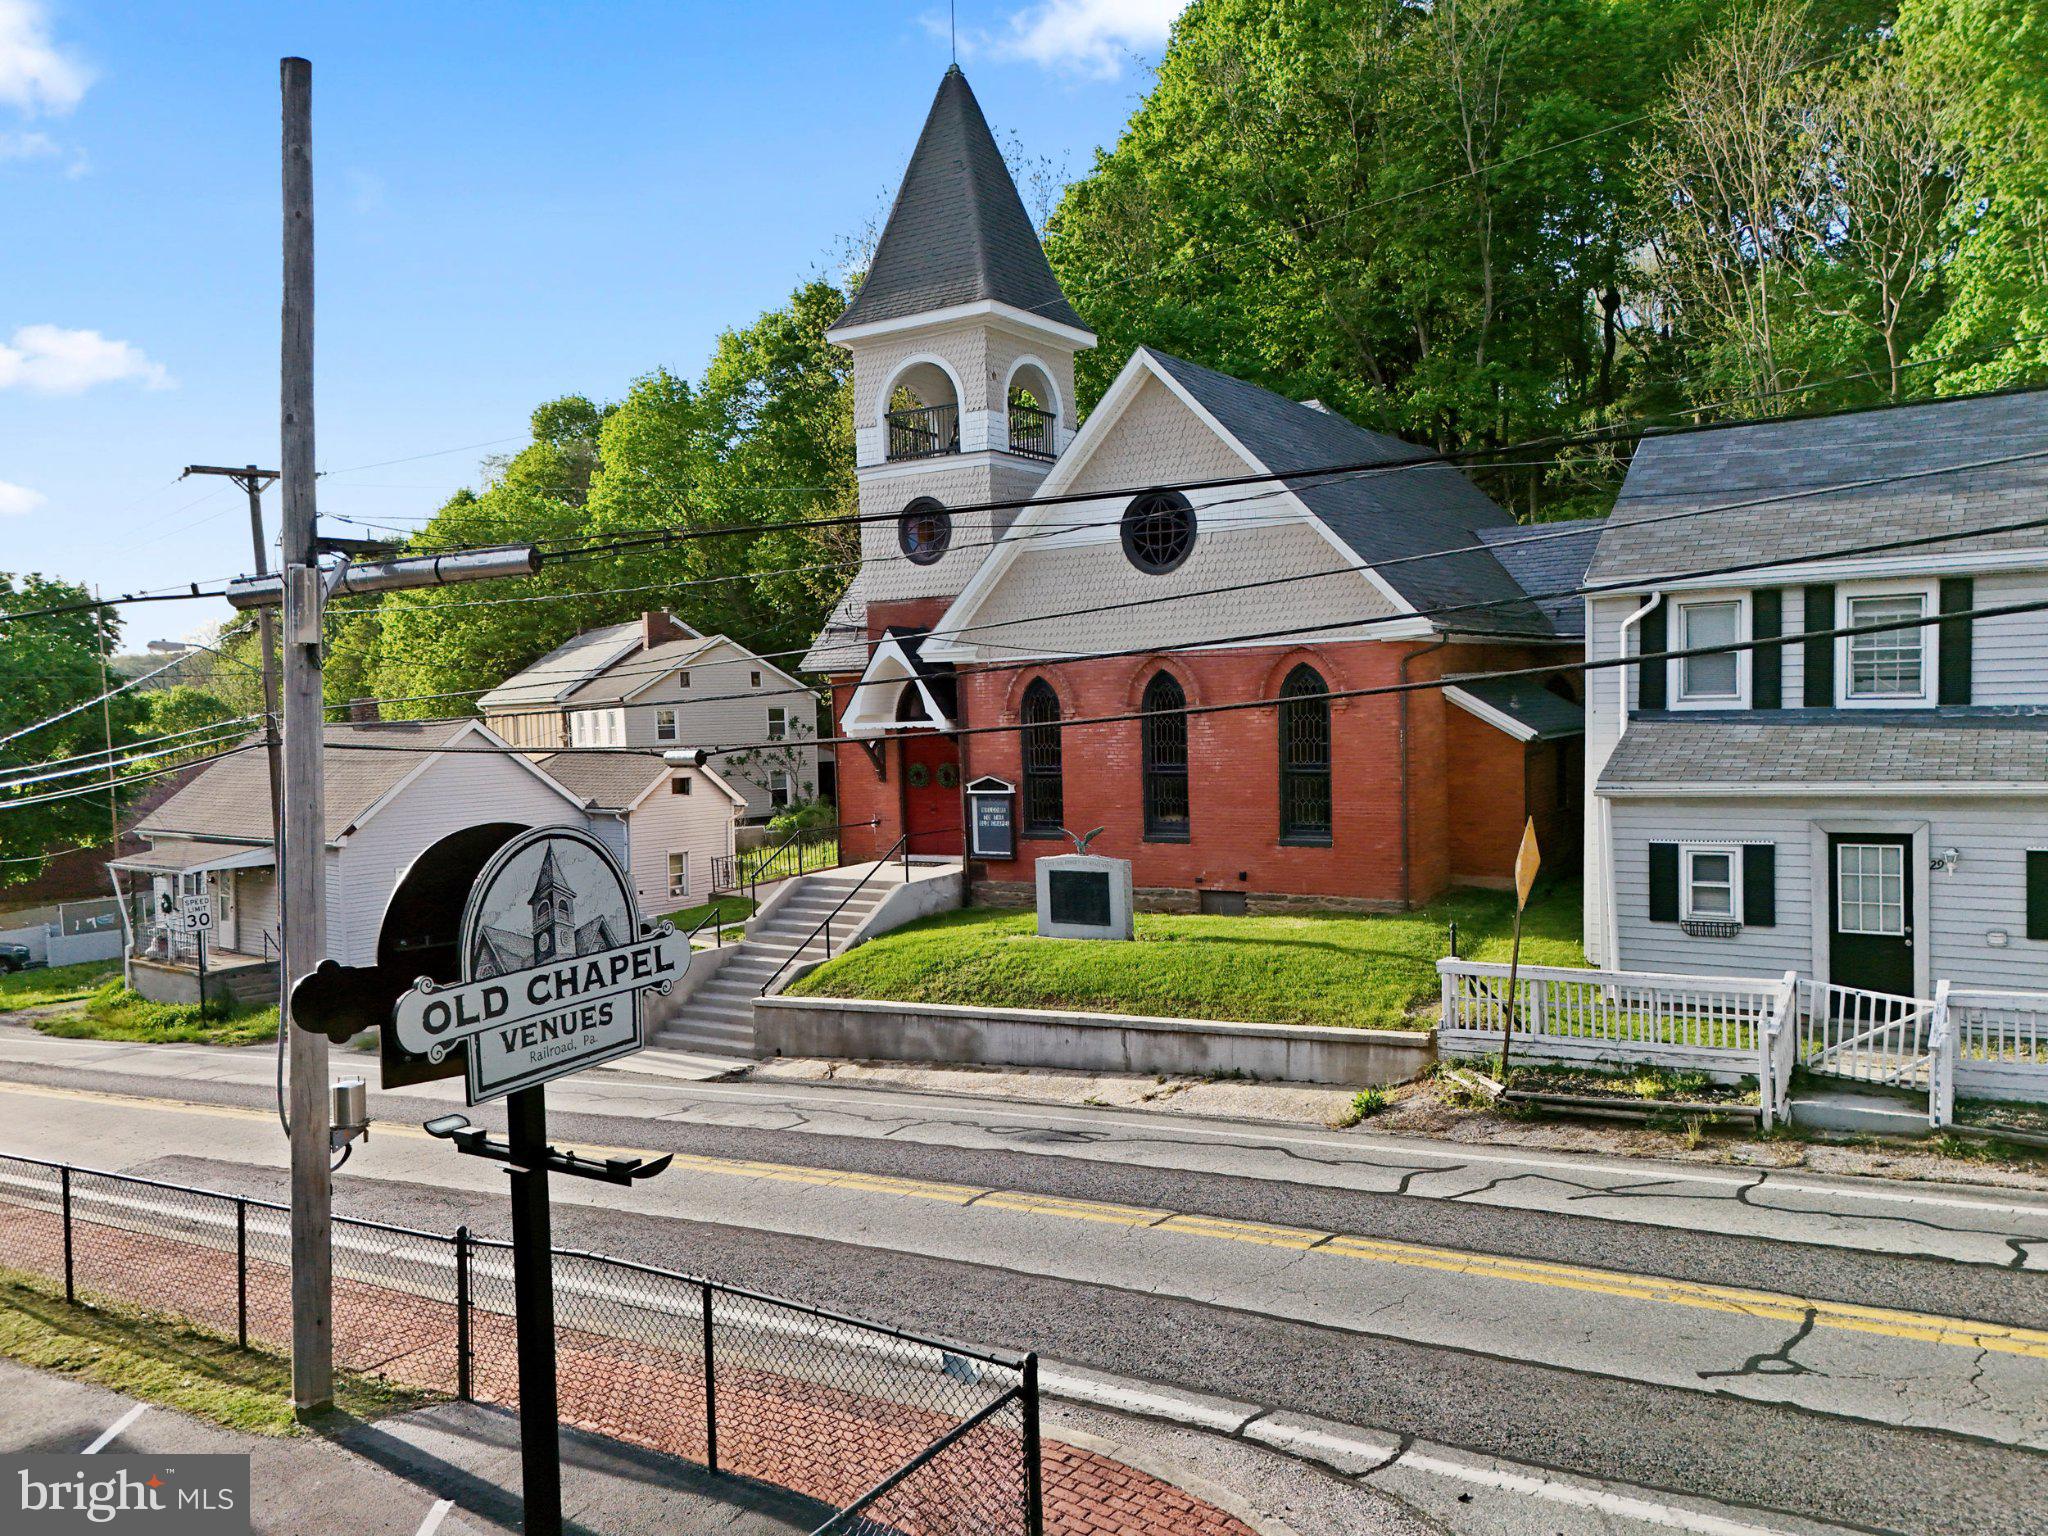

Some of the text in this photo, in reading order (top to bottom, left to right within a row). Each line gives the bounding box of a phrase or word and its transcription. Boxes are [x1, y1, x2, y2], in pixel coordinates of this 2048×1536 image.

[185, 898, 209, 906] SPEED
[188, 905, 207, 913] LIMIT
[187, 913, 210, 928] 30
[422, 944, 675, 1035] OLD CHAPEL
[499, 1001, 614, 1054] VENUES
[529, 1034, 599, 1064] Railroad, Pa.
